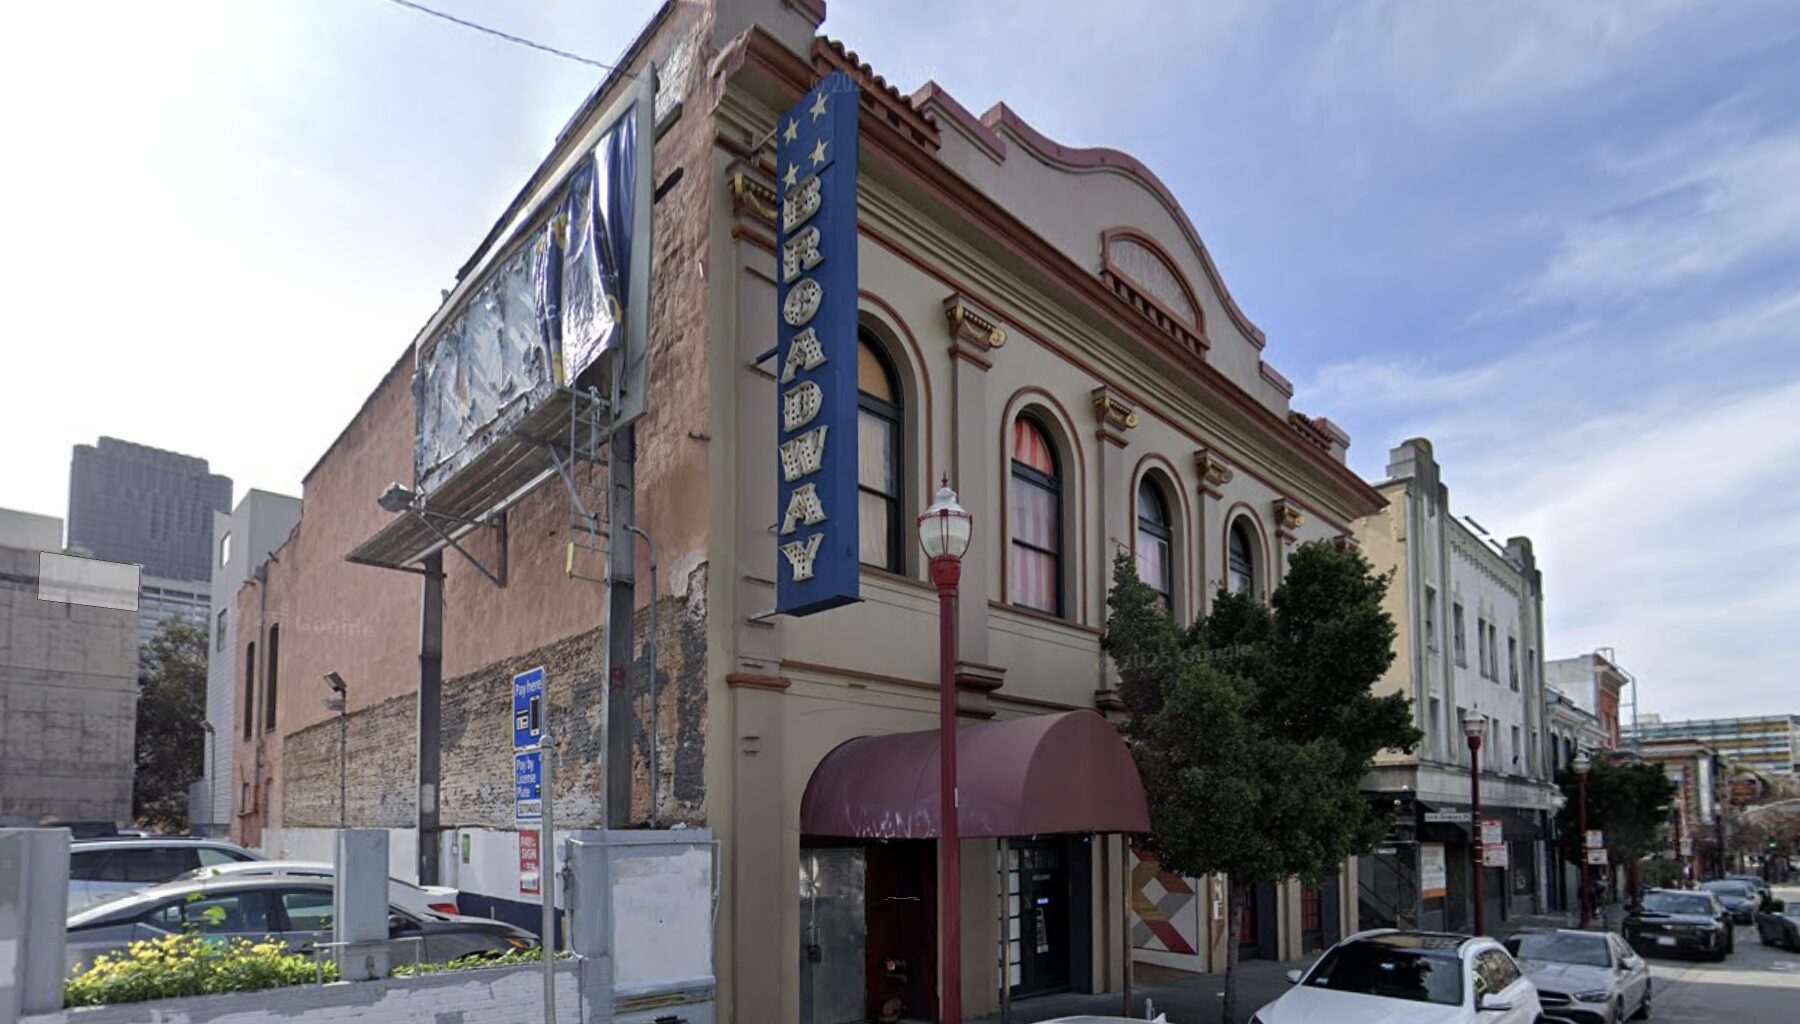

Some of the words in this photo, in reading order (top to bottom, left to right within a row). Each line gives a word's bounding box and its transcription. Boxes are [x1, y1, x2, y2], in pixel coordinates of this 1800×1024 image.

[780, 173, 828, 582] BROADWAY
[515, 683, 526, 698] Pay
[527, 679, 542, 693] here
[516, 758, 526, 773] Pay
[527, 756, 535, 773] by
[516, 786, 531, 798] Plate
